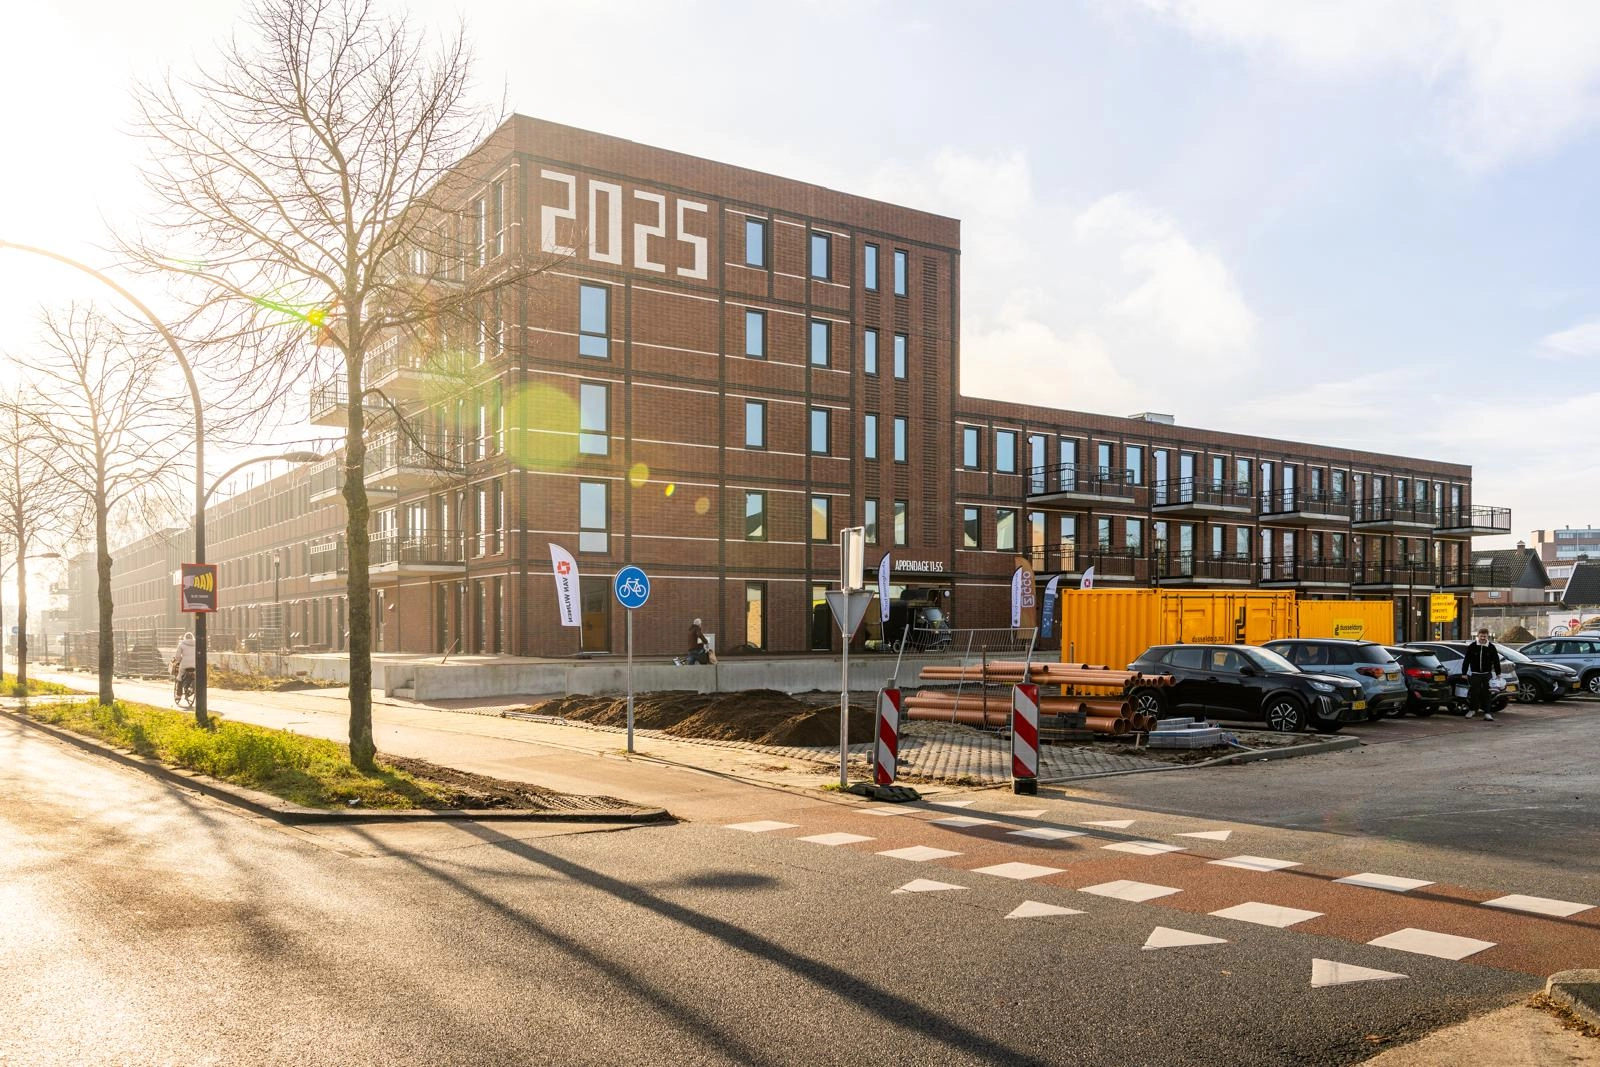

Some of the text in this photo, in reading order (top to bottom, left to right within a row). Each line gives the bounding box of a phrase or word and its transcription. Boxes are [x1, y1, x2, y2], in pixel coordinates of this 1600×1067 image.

[541, 169, 707, 280] 2025
[895, 560, 929, 571] APPENDAGE
[194, 572, 213, 592] AAN
